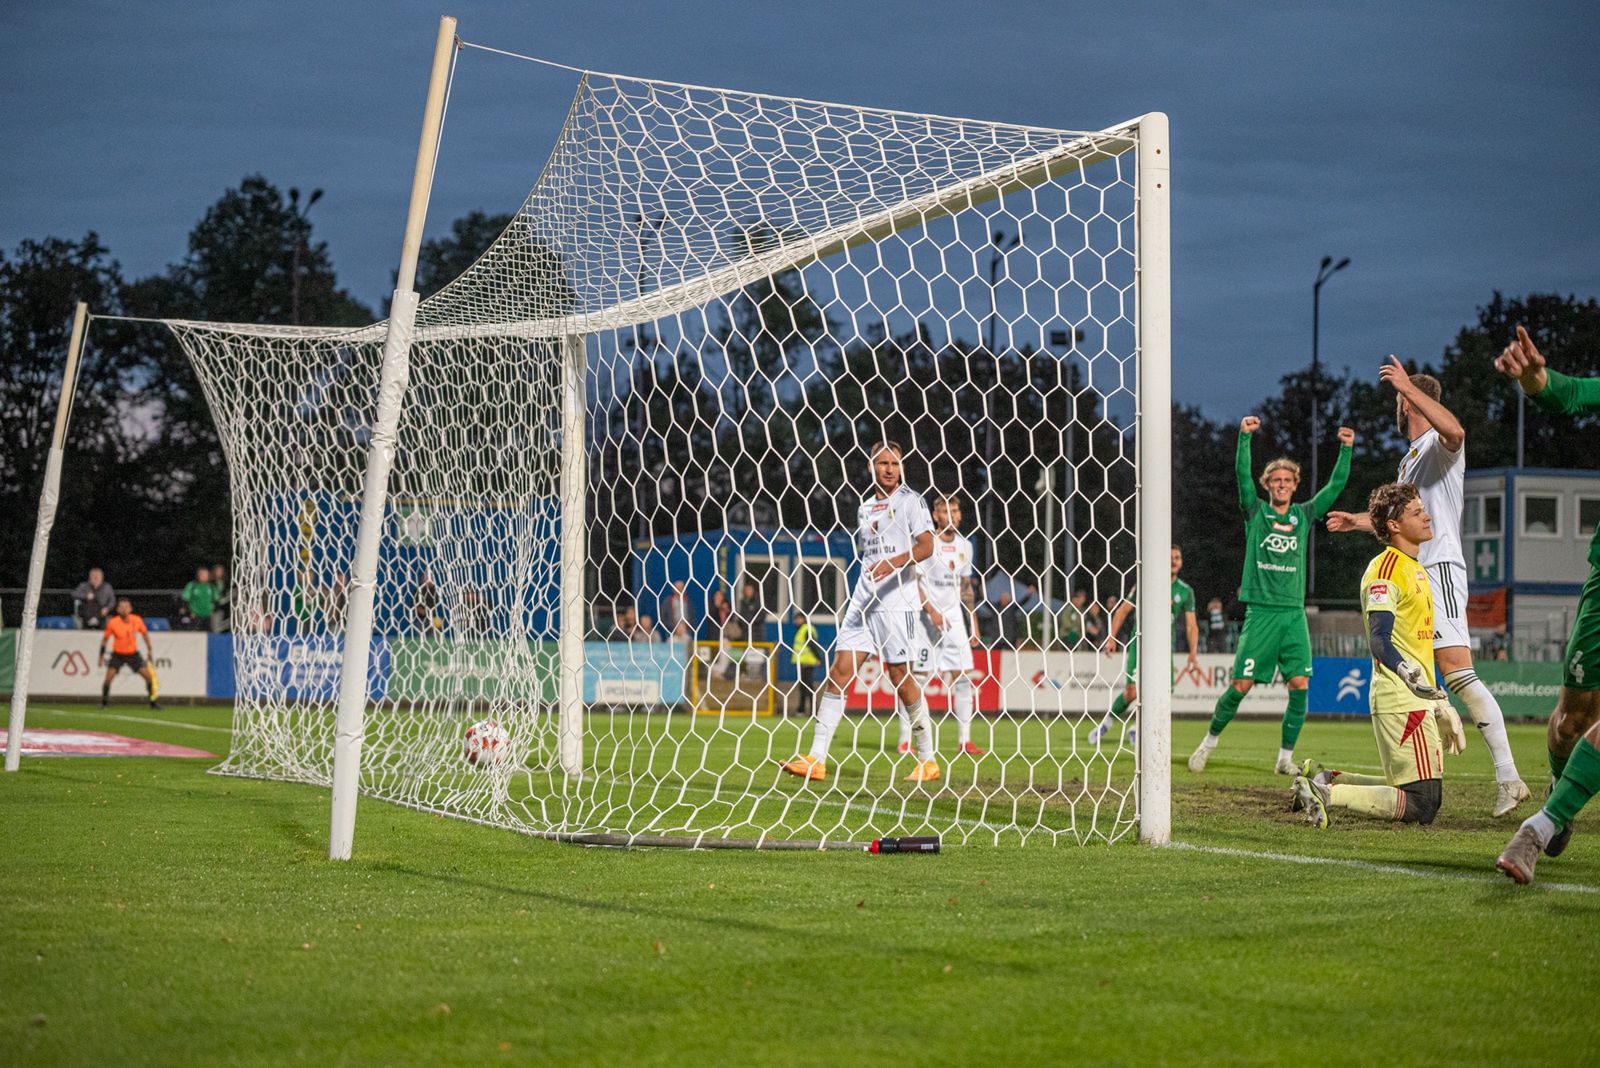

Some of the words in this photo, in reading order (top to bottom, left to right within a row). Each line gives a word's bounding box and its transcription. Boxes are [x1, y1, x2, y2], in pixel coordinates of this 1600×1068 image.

[920, 648, 929, 662] 9
[1243, 658, 1255, 676] 2
[1569, 650, 1584, 684] 4
